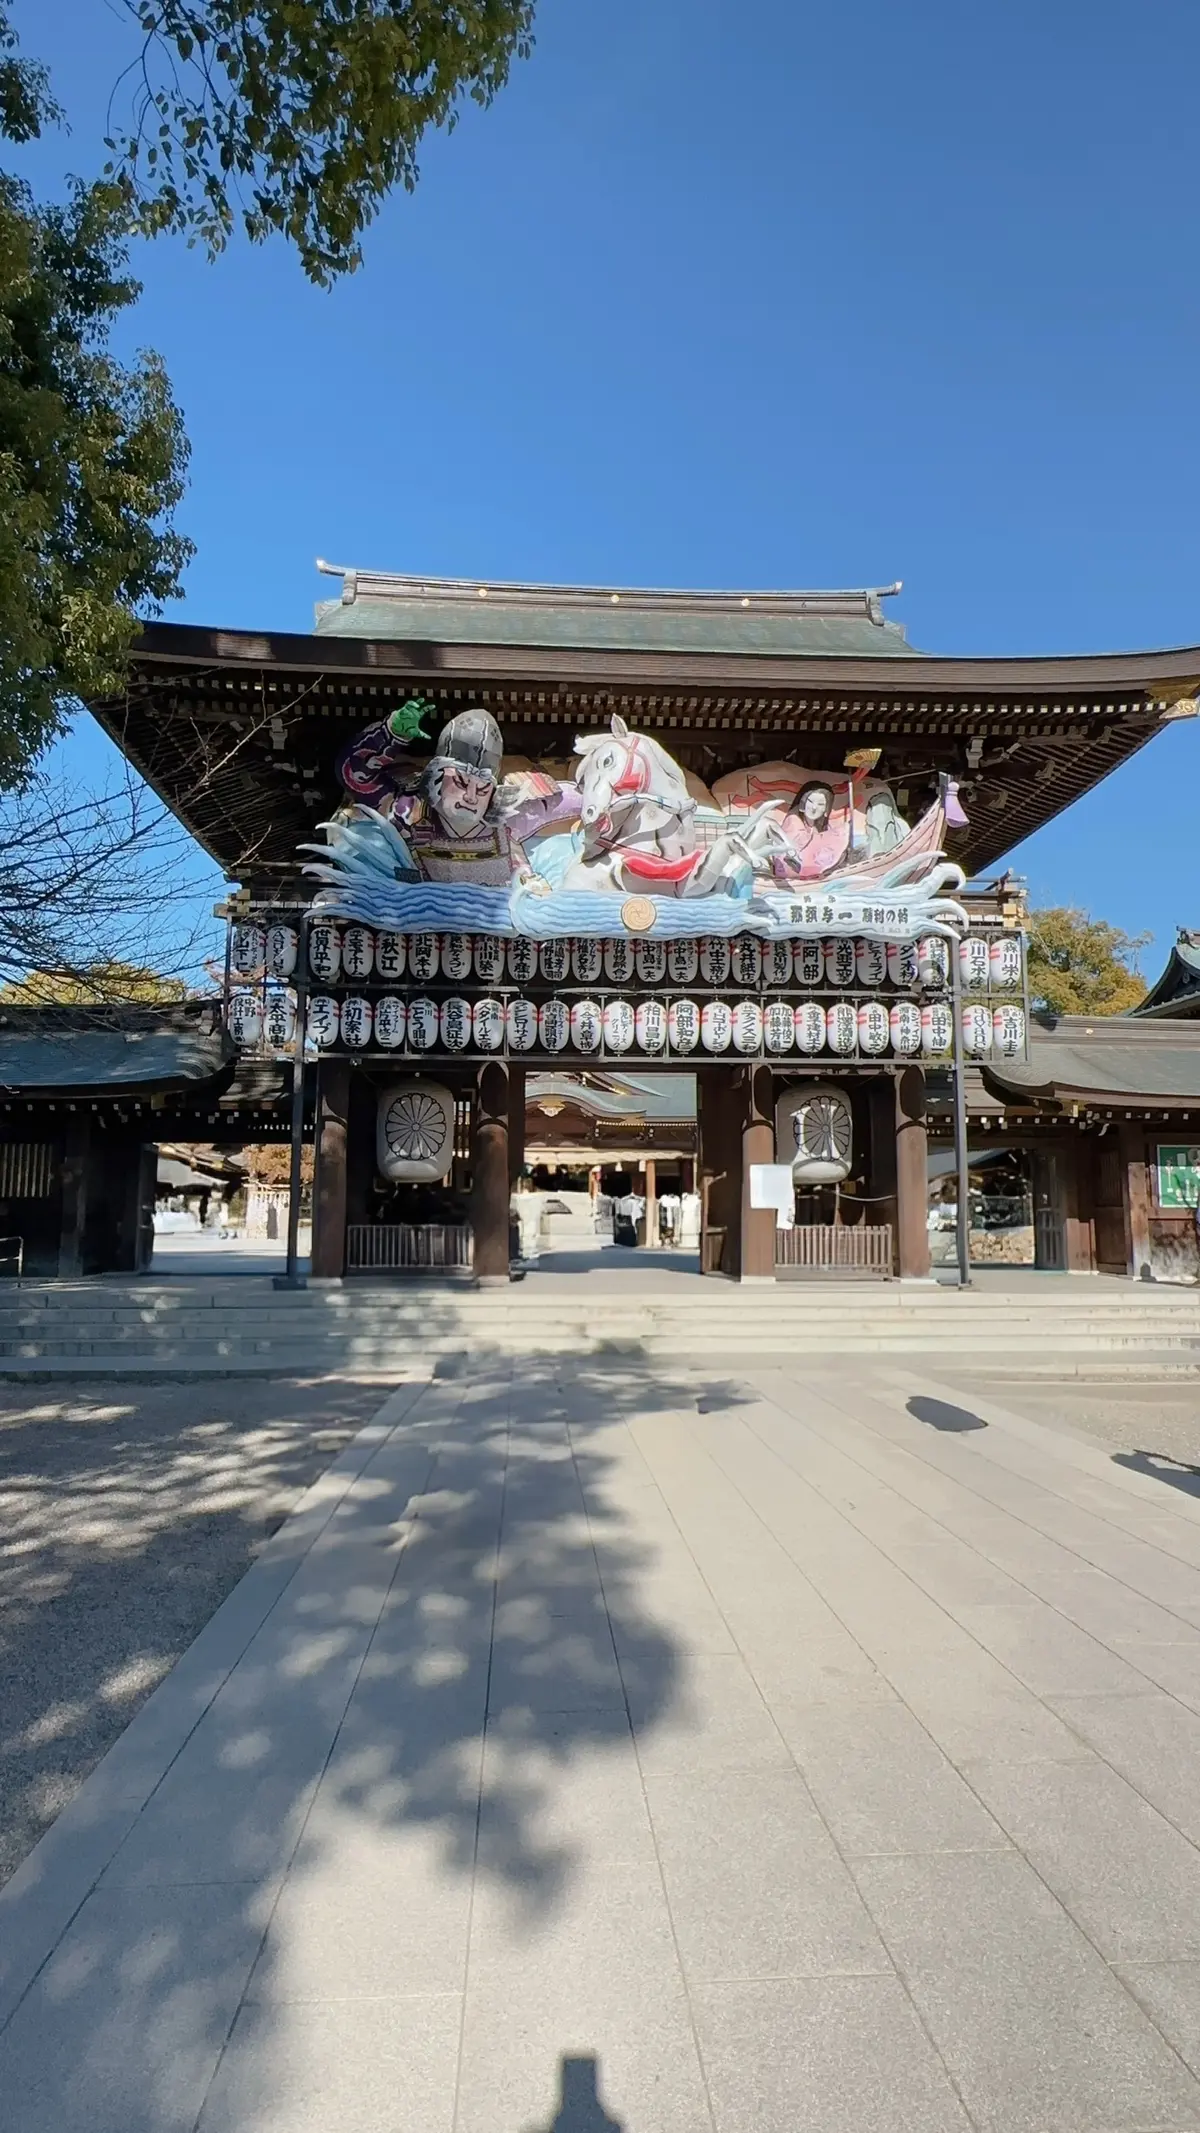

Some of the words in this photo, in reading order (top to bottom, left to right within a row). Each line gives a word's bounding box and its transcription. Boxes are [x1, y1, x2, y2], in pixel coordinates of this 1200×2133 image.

[790, 905, 853, 923] 那須与一
[313, 929, 331, 974] 世界平和
[642, 945, 656, 980] 中島一夫
[674, 947, 688, 981] 中島一夫
[802, 946, 819, 980] 阿部
[244, 998, 256, 1017] 中野
